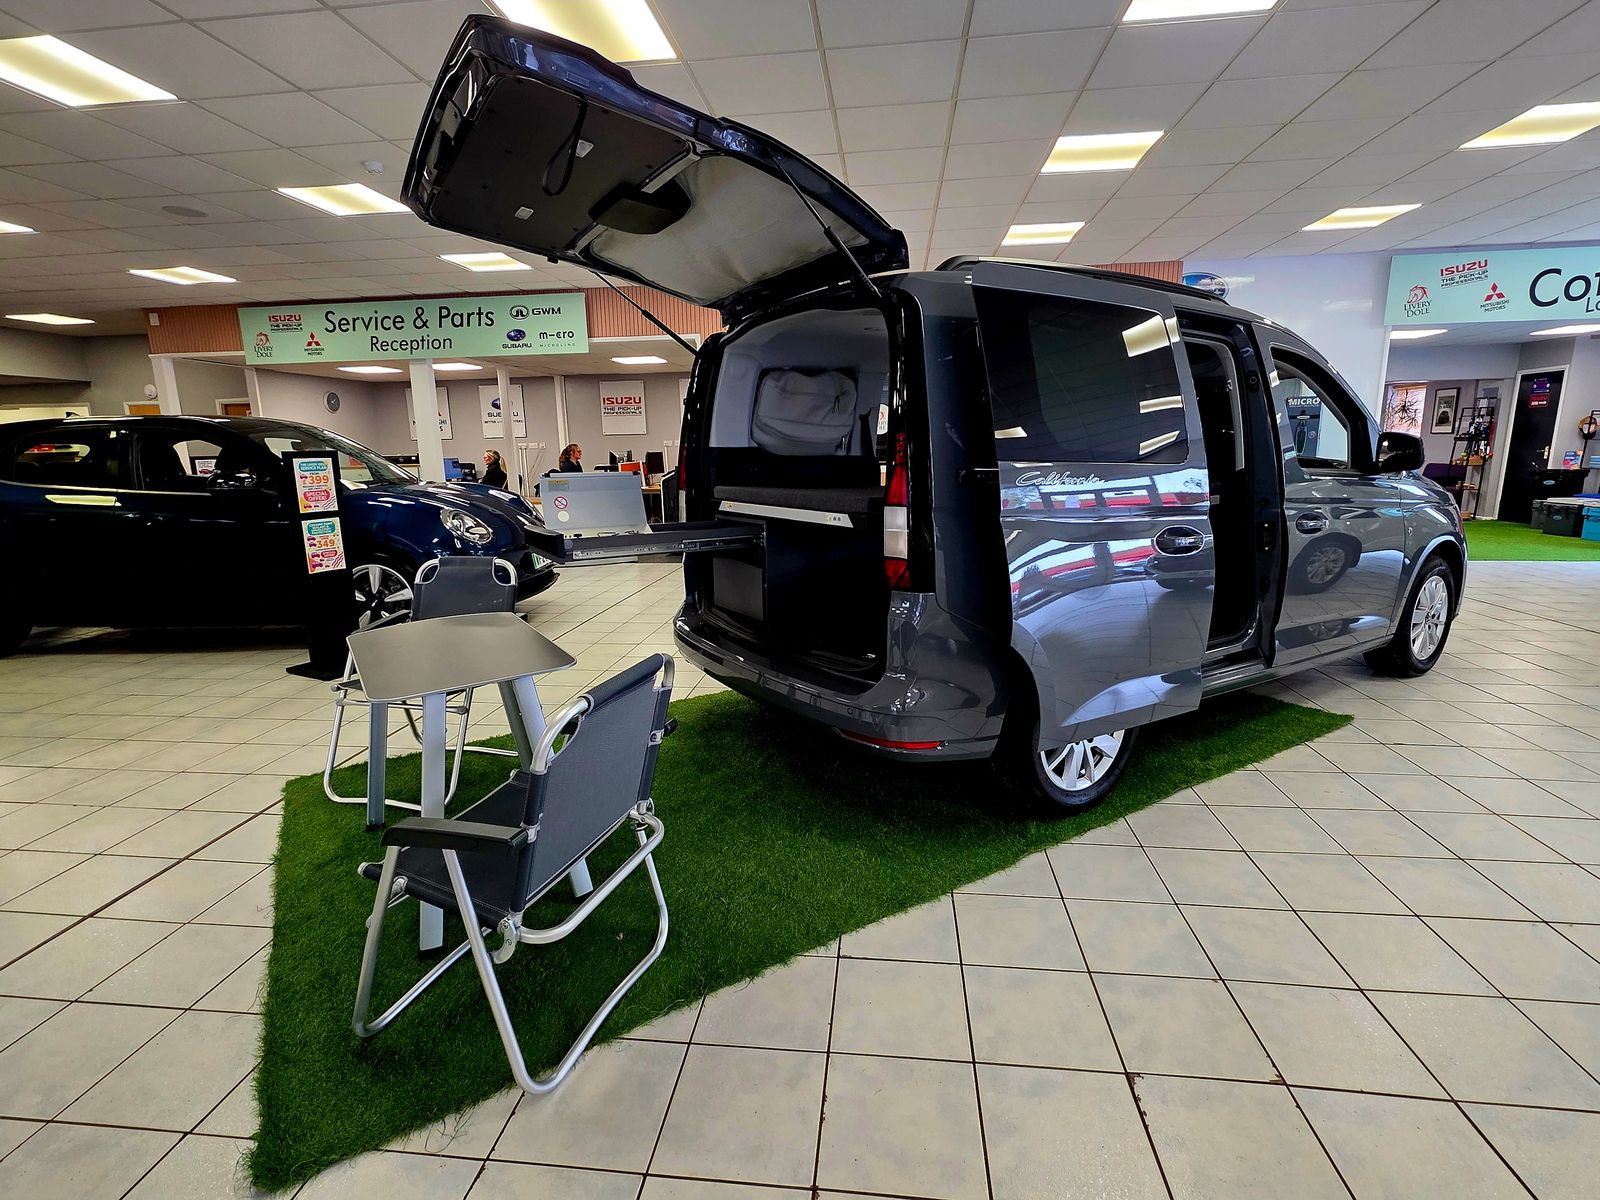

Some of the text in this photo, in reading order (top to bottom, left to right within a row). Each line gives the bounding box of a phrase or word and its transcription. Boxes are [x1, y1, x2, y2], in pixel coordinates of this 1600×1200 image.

[1440, 259, 1488, 276] ISUZU
[1458, 270, 1488, 280] PICK-UP
[1441, 275, 1488, 287] PROFESSIONALS
[1404, 300, 1432, 312] LIVERY
[1480, 299, 1510, 308] MITSUBISHI
[531, 307, 561, 316] GWM
[1406, 308, 1430, 318] DOLE
[268, 314, 302, 323] ISUZU
[324, 304, 496, 334] Service & Parts
[254, 345, 273, 353] LIVERY
[370, 334, 453, 356] Reception
[603, 396, 642, 405] ISUZU
[1016, 472, 1105, 487] California
